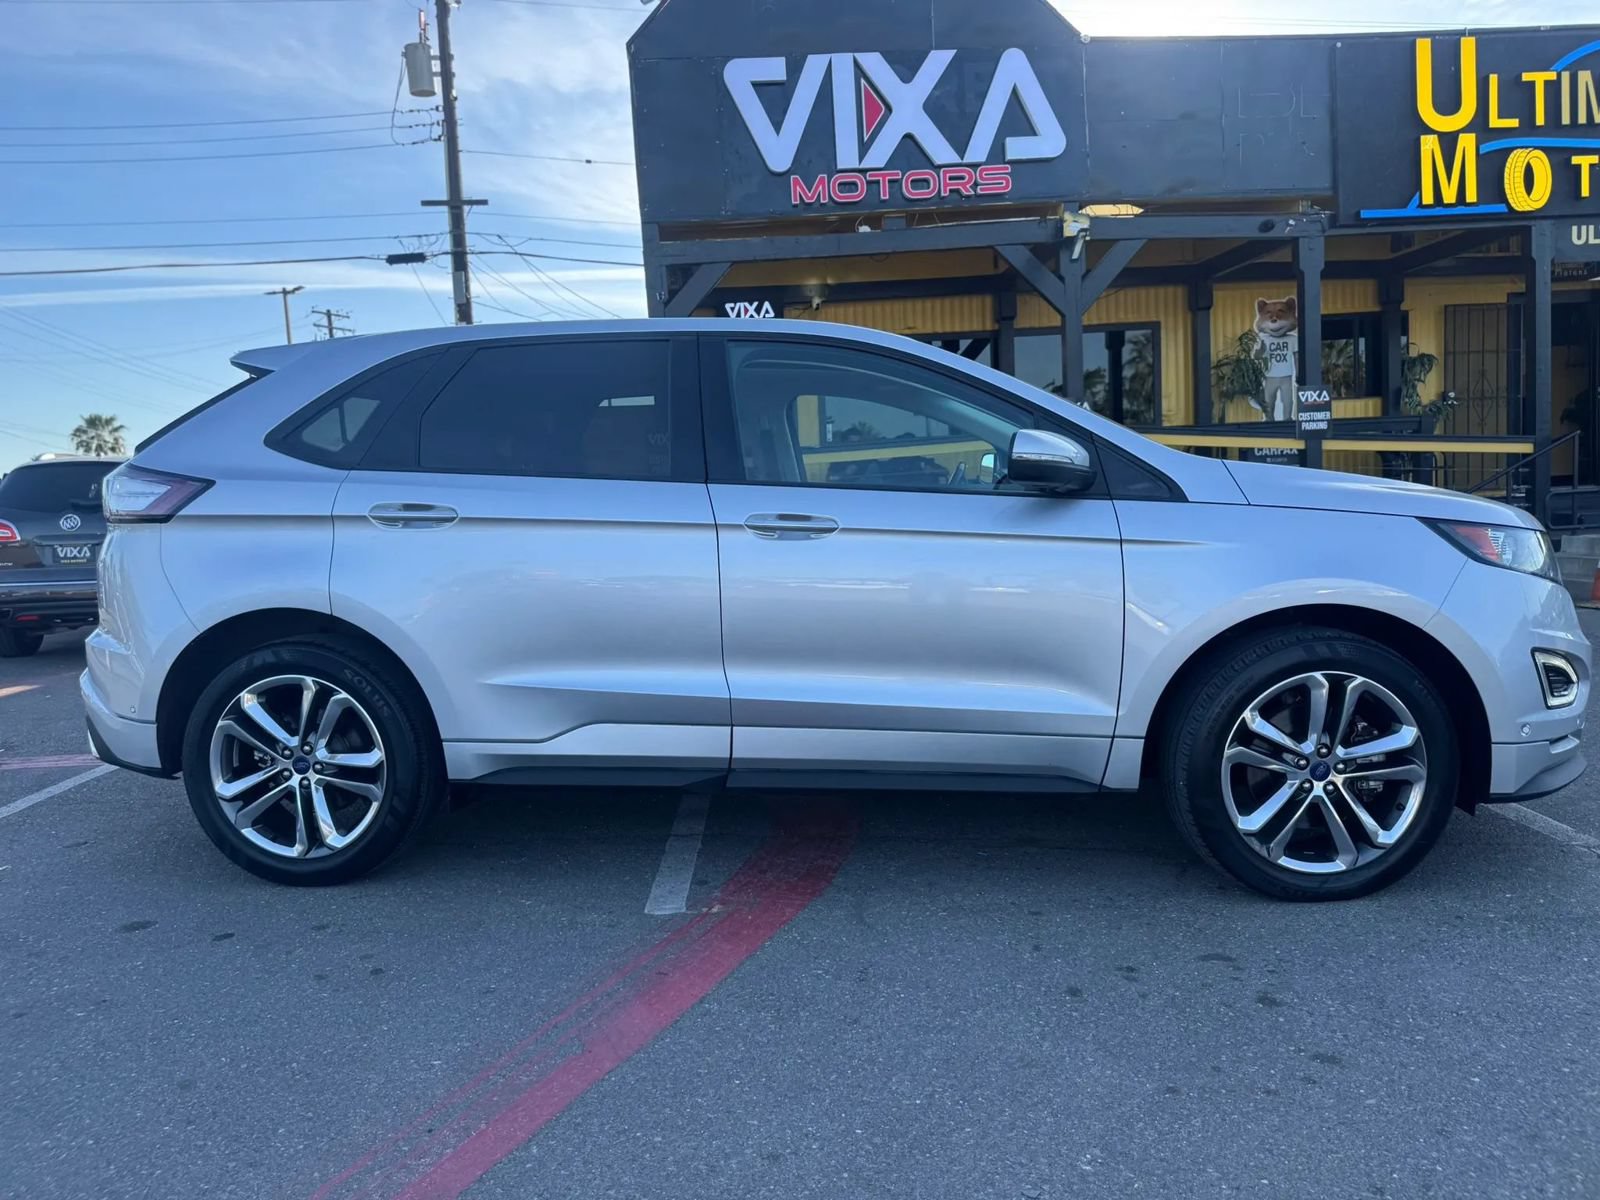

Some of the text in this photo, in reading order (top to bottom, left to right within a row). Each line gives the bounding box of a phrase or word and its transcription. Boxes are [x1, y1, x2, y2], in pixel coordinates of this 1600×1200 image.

[723, 47, 1067, 173] VIXA
[791, 164, 1012, 204] MOTORS
[725, 301, 775, 318] VIXA
[1269, 341, 1289, 351] CAR
[1269, 353, 1288, 363] FOX
[1298, 390, 1330, 402] VIXA
[1299, 411, 1330, 421] CUSTOMER
[1302, 421, 1328, 430] PARKING
[1254, 448, 1299, 456] CARFAX
[57, 546, 91, 557] VIXA
